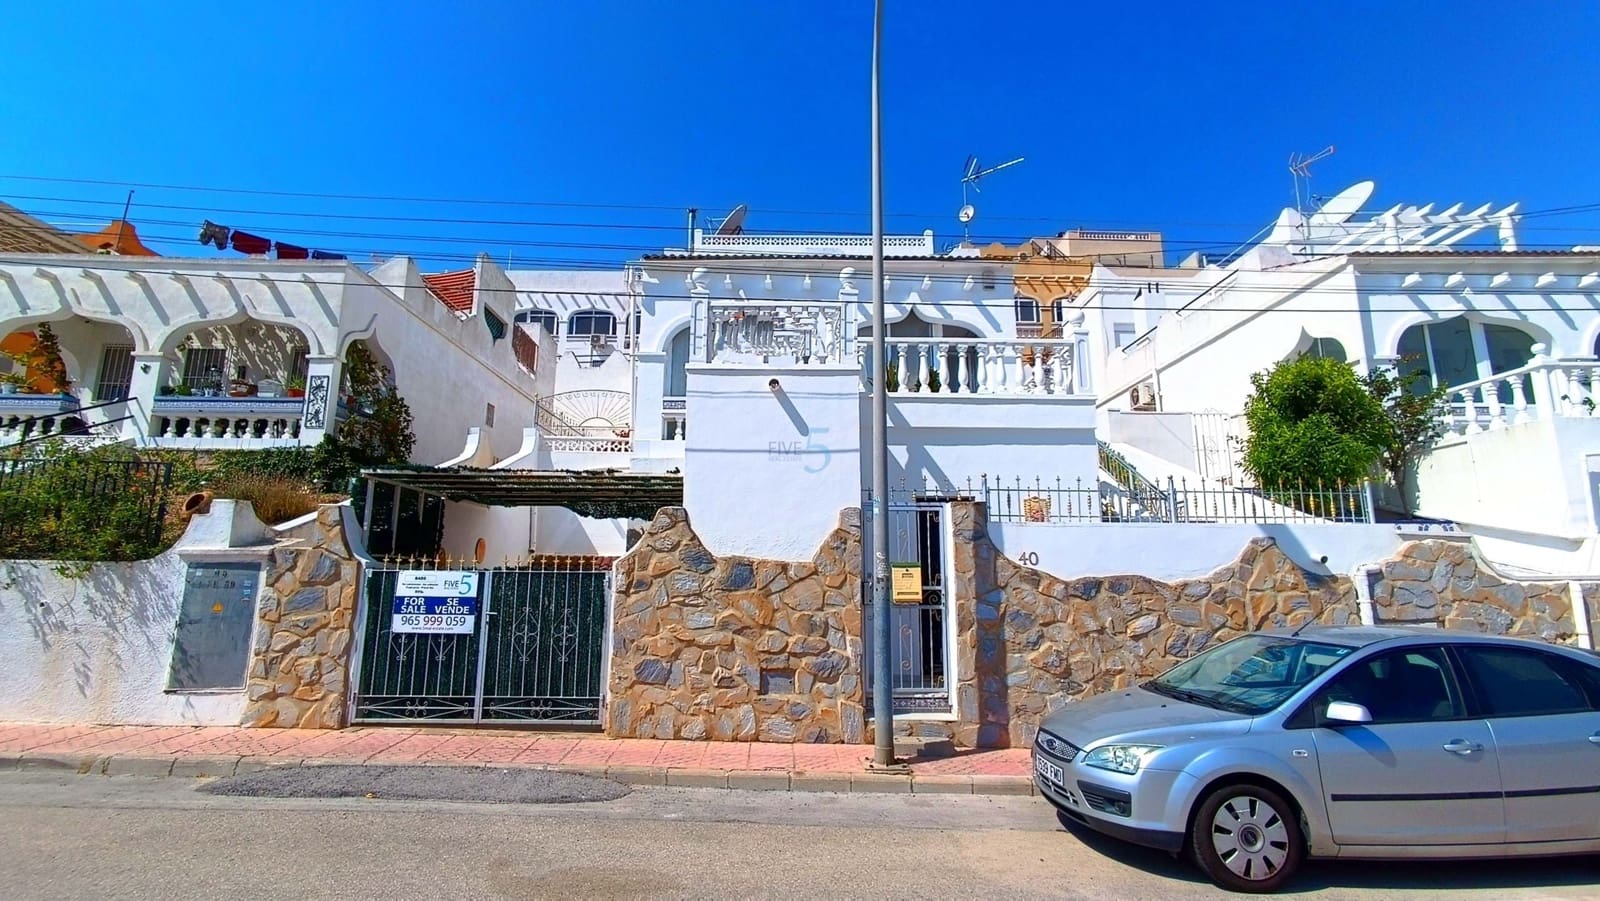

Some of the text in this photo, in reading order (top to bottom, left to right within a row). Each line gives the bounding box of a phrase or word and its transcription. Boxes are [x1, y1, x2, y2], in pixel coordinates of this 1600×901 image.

[1018, 551, 1040, 566] 40
[443, 574, 472, 595] FIVE 5
[403, 597, 425, 606] FOR
[446, 597, 460, 606] SE
[400, 605, 427, 614] SALE
[434, 605, 470, 614] VENDE
[401, 615, 466, 627] 965 999 059
